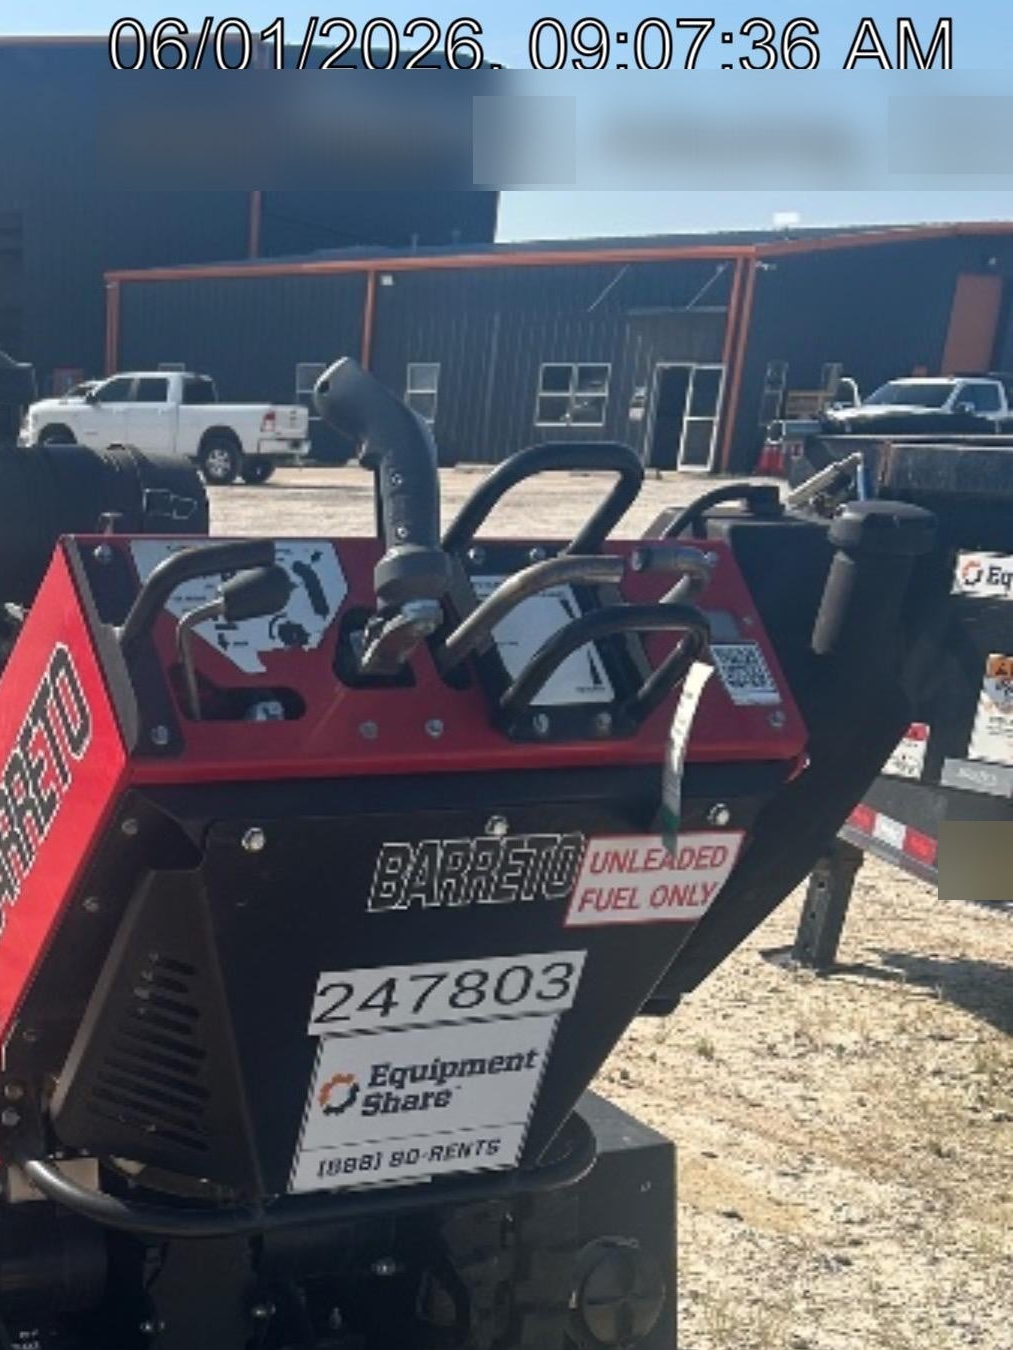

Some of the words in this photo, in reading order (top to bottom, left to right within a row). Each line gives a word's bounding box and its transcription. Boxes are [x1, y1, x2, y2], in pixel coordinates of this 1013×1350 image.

[368, 832, 585, 912] BARRETO
[590, 844, 729, 874] UNLEADED
[577, 886, 640, 912] FUEL
[649, 880, 718, 908] ONLY
[314, 962, 575, 1023] 247803
[367, 1047, 540, 1090] Equipment
[361, 1087, 454, 1117] Share
